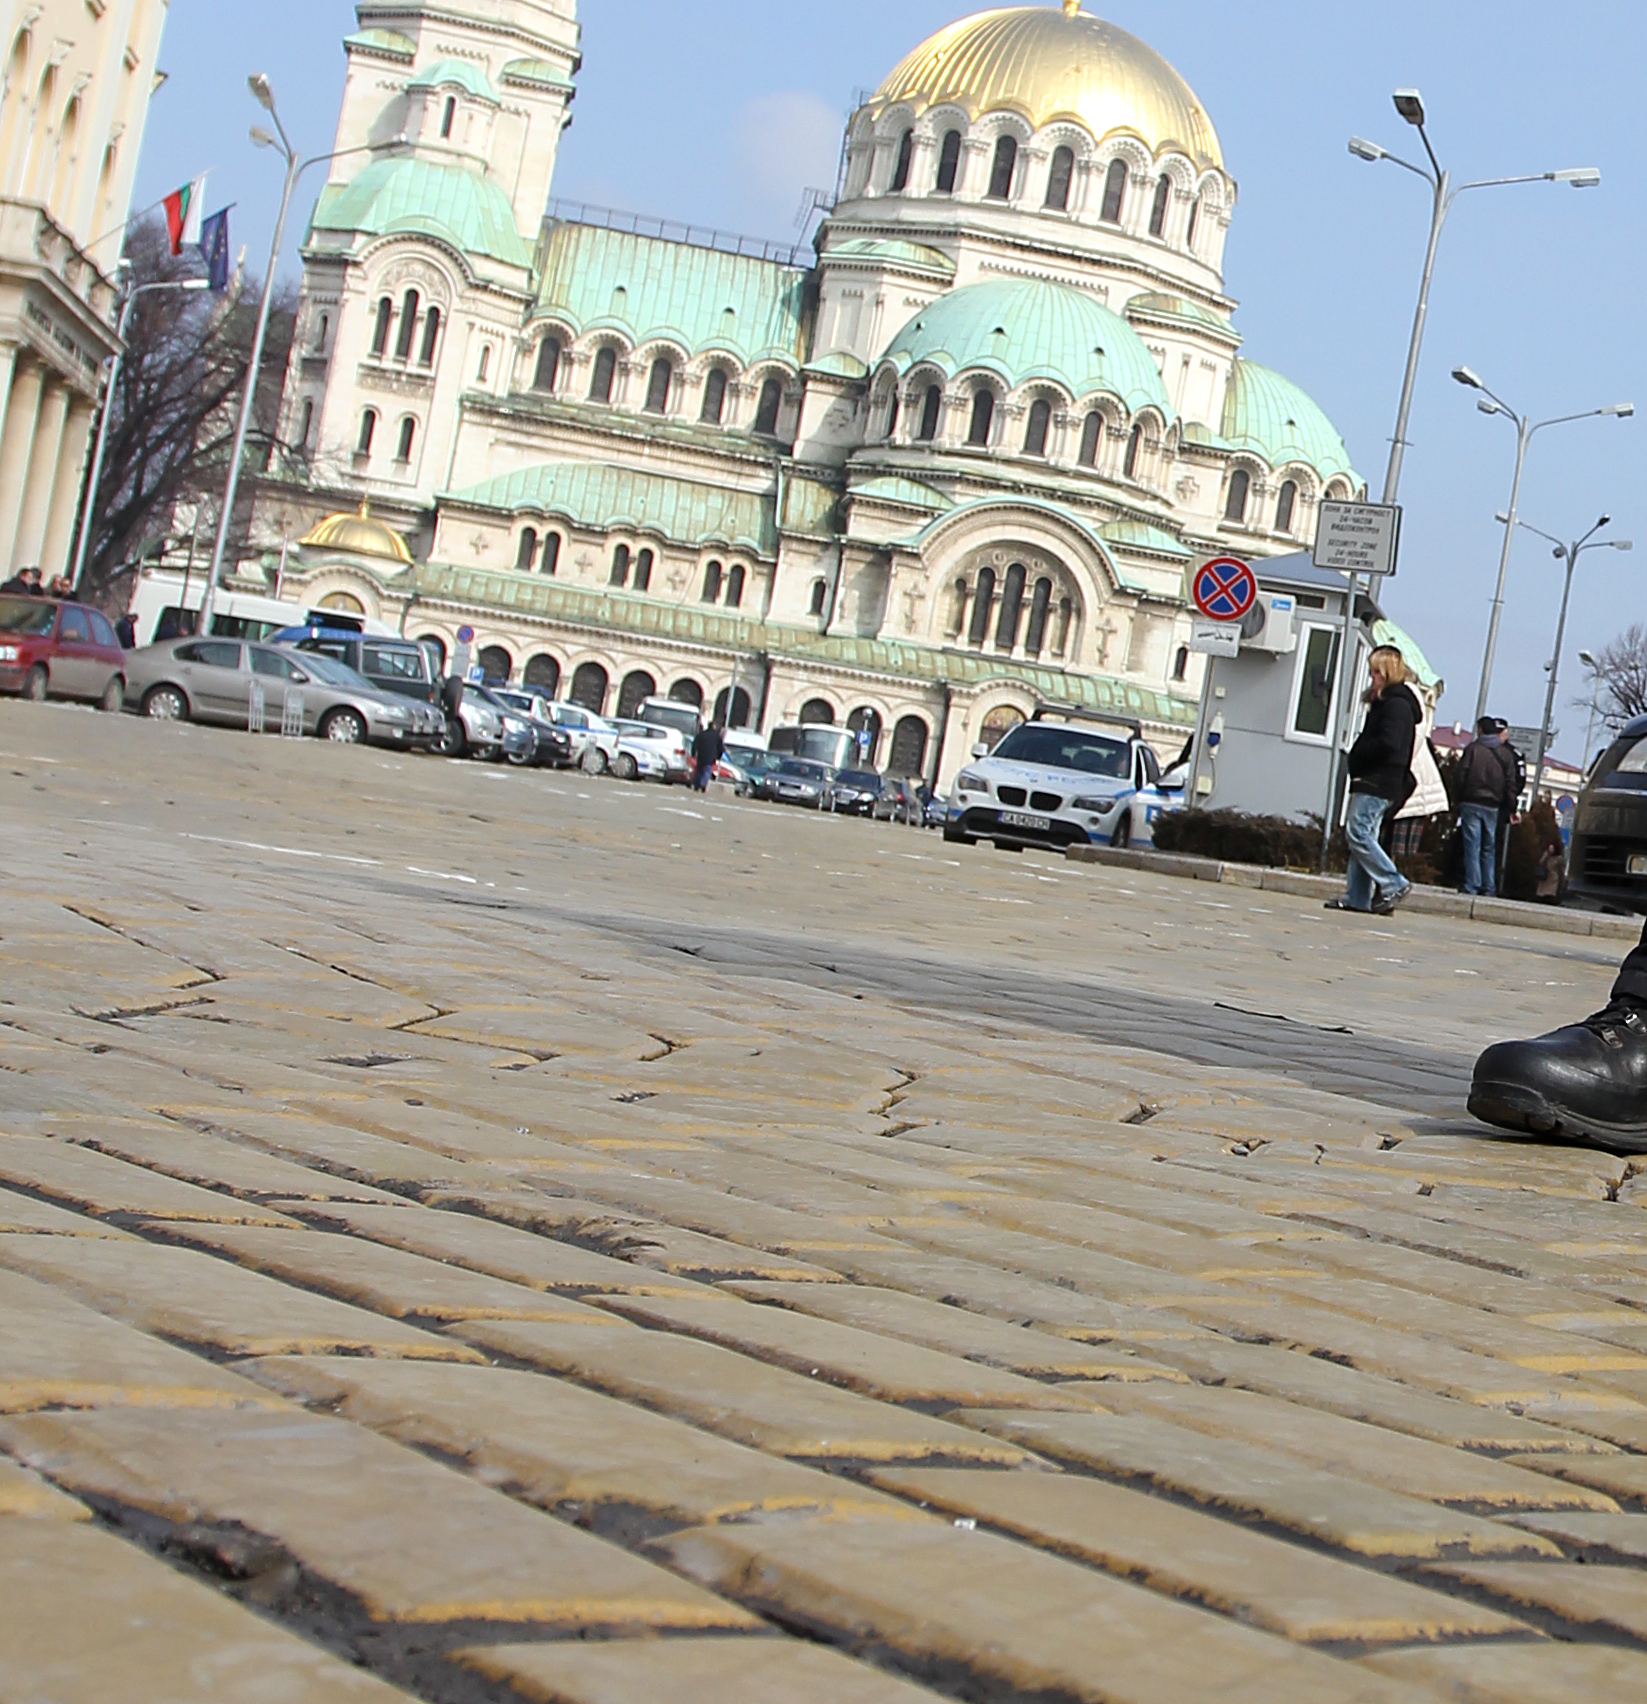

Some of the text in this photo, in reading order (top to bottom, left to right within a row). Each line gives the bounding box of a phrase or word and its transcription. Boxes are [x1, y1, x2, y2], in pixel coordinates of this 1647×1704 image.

[1327, 538, 1378, 550] SECURITY ZONE
[1327, 557, 1375, 568] VIDEO CONTROL
